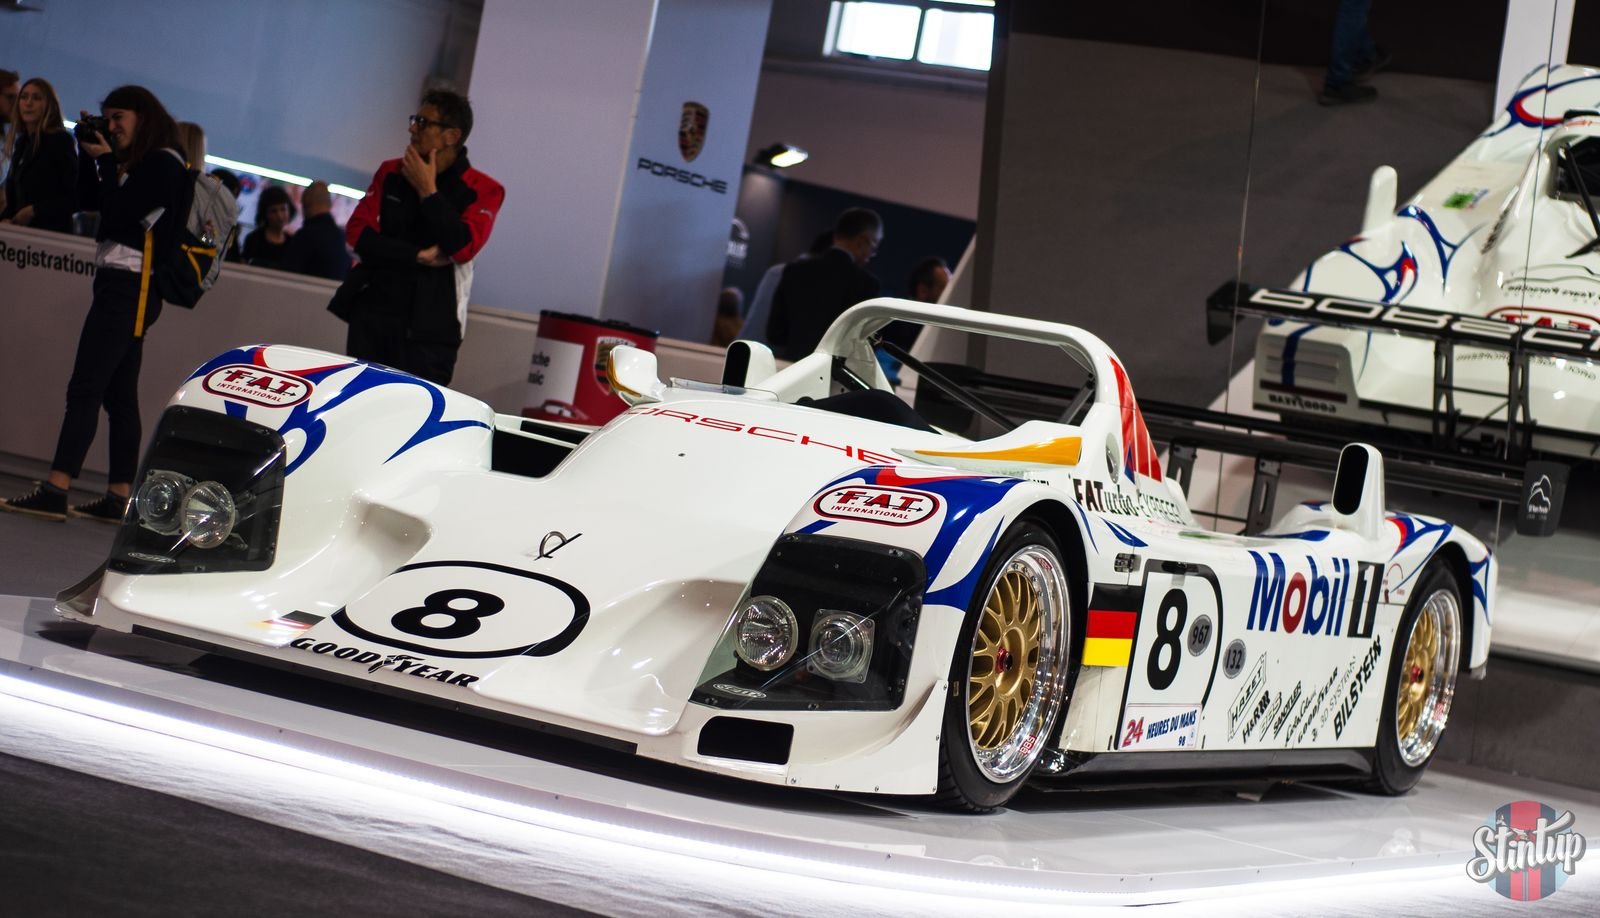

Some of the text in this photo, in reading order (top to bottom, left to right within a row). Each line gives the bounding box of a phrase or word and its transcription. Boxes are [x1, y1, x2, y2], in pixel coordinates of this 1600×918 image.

[637, 157, 728, 194] PORSCHE
[0, 241, 96, 277] Registration
[217, 382, 282, 402] INTERNATIONAL
[624, 407, 903, 465] ORSCHE
[831, 505, 909, 520] INTERNATIONAL
[391, 588, 505, 639] 8
[1246, 550, 1381, 638] Mobil 1
[1147, 588, 1188, 690] 8
[1191, 625, 1210, 645] 967
[290, 637, 479, 688] GOODYEAR
[1225, 648, 1243, 669] 132
[1231, 665, 1262, 730] HAZET
[1333, 634, 1382, 741] BILSTEIN
[1122, 709, 1198, 748] 24 HEURES DU MANS
[1178, 735, 1186, 747] 98
